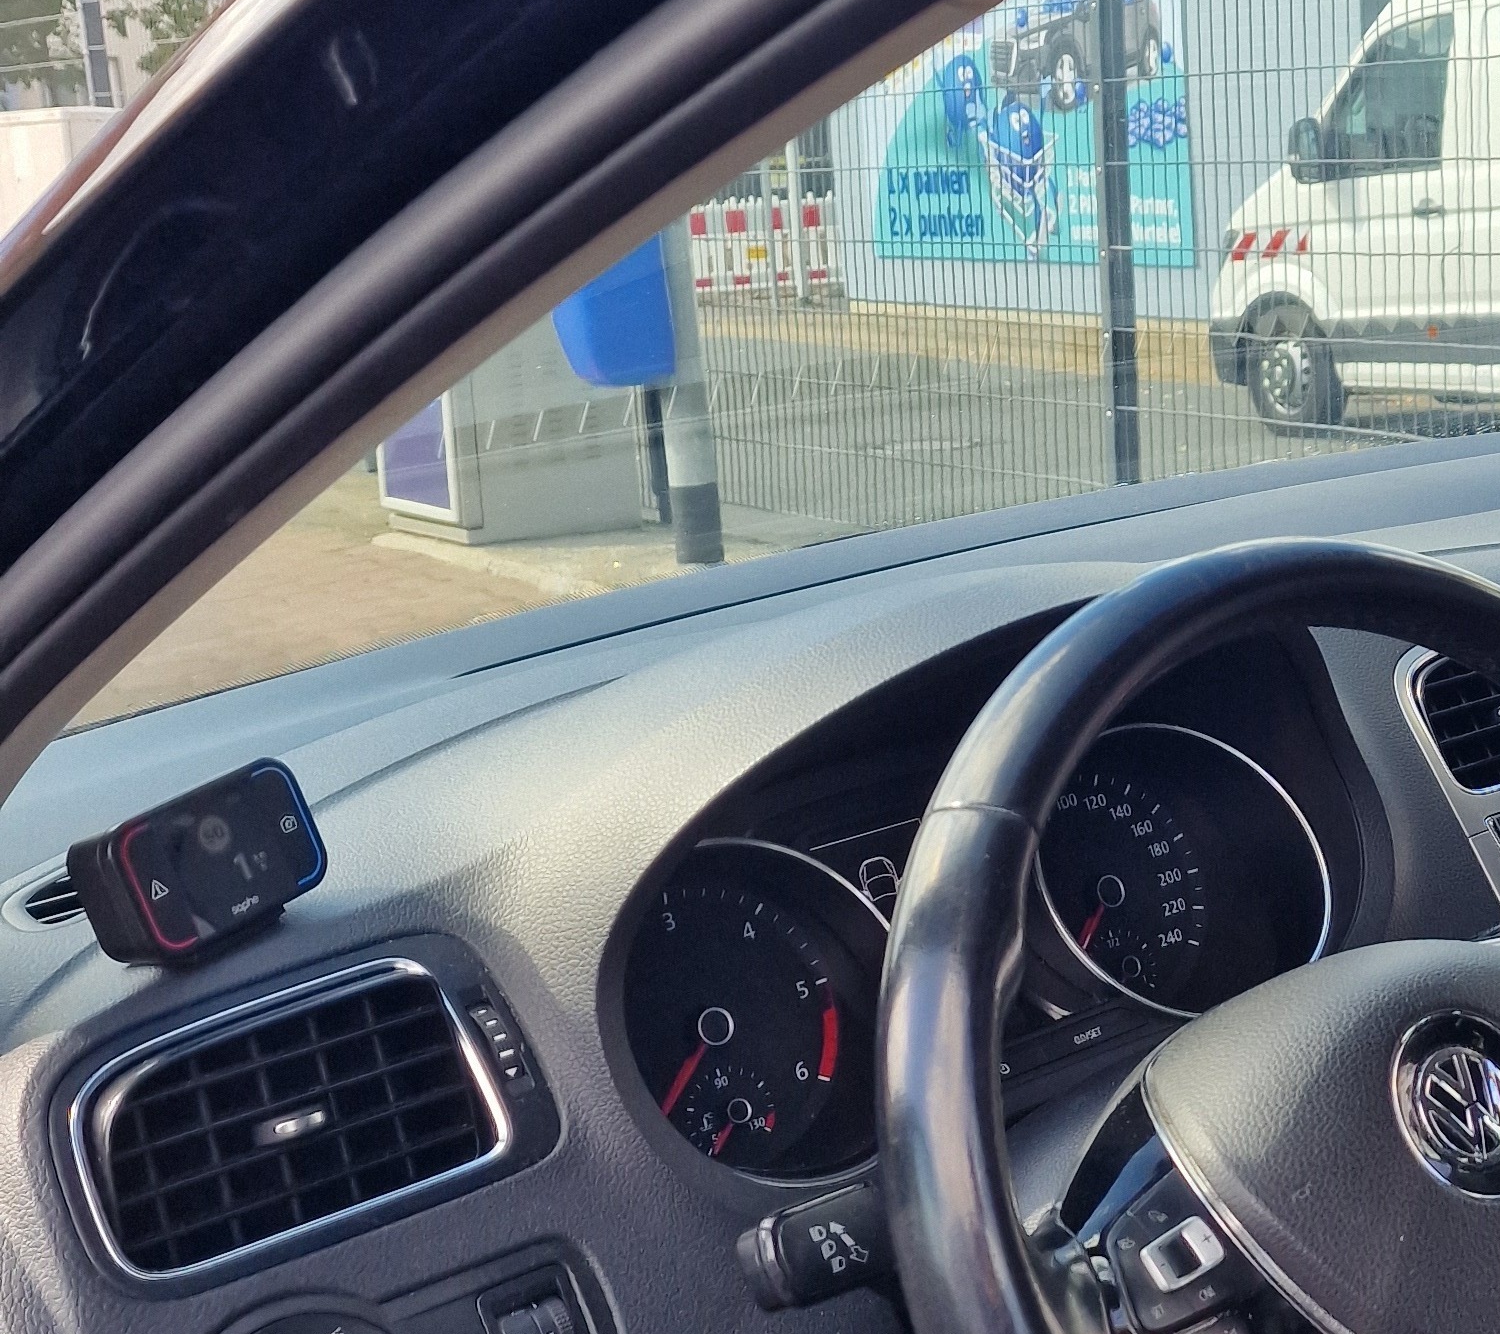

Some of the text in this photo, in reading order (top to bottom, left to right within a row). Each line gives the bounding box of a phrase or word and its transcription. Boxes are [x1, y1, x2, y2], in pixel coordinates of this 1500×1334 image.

[918, 207, 985, 243] punkten
[1056, 793, 1078, 811] 100
[1083, 793, 1107, 811] 120
[1109, 803, 1132, 821] 140
[1130, 819, 1153, 837] 160
[1147, 840, 1170, 858] 180
[1157, 868, 1182, 887] 200
[1162, 897, 1186, 918] 220
[662, 912, 676, 931] 3
[743, 921, 756, 939] 4
[1158, 928, 1182, 947] 240
[795, 980, 809, 999] 5
[795, 1060, 809, 1080] 6
[714, 1076, 728, 1089] 90
[749, 1117, 766, 1130] 130
